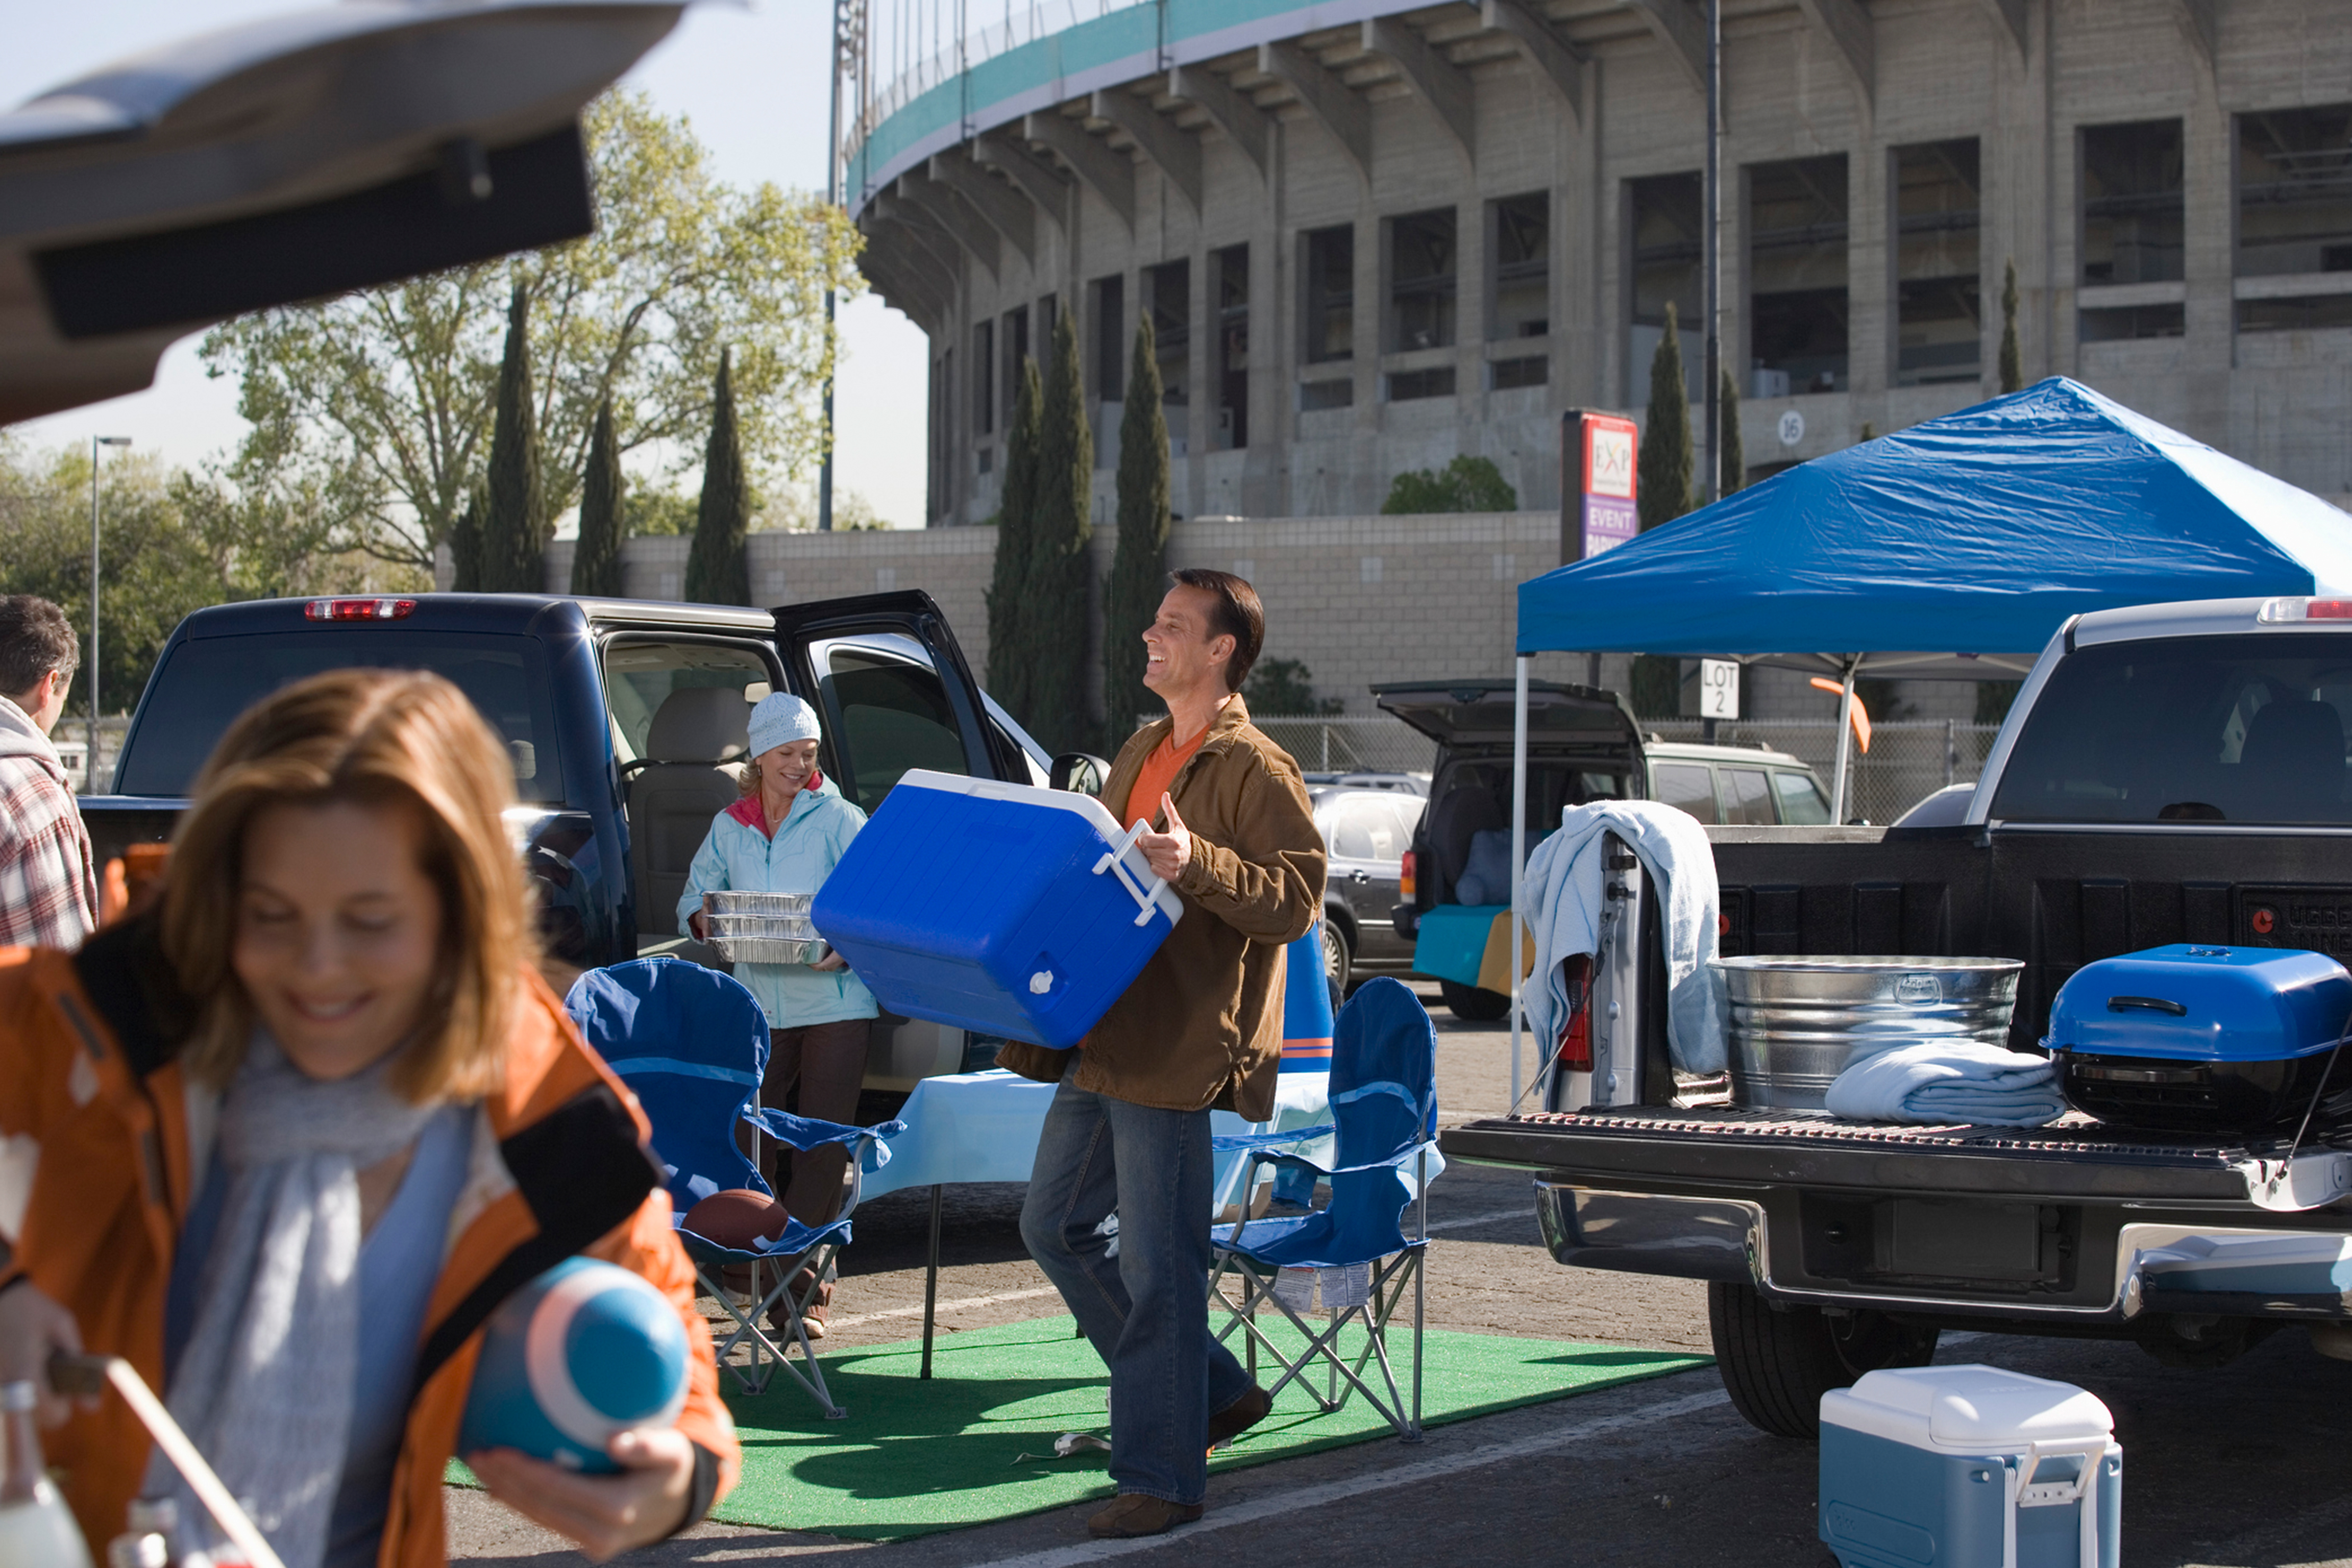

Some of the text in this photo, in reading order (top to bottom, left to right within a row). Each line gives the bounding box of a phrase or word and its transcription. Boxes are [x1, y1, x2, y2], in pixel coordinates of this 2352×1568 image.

[1784, 418, 1799, 438] 16
[1589, 507, 1632, 530] EVENT
[1704, 665, 1736, 688] LOT
[1716, 691, 1724, 713] 2
